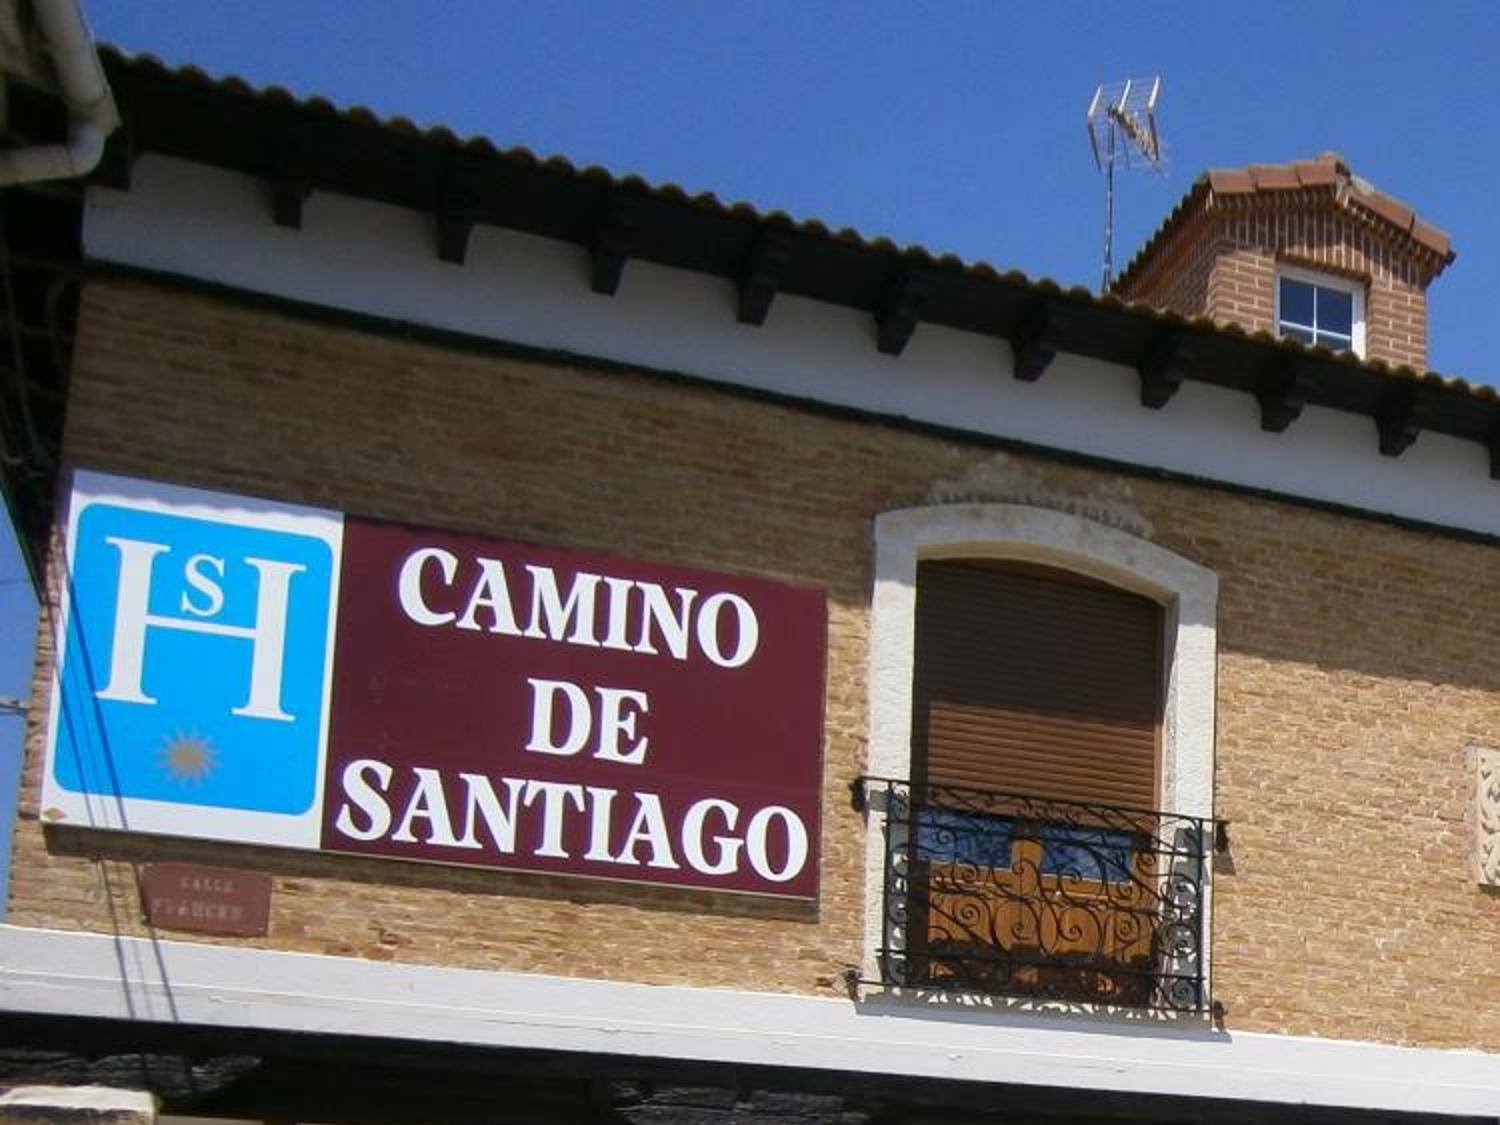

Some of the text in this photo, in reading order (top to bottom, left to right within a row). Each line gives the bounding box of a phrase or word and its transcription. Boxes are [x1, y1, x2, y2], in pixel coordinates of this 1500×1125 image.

[398, 546, 761, 669] CAMINO
[525, 677, 650, 764] DE
[334, 758, 809, 884] SANTIAGO
